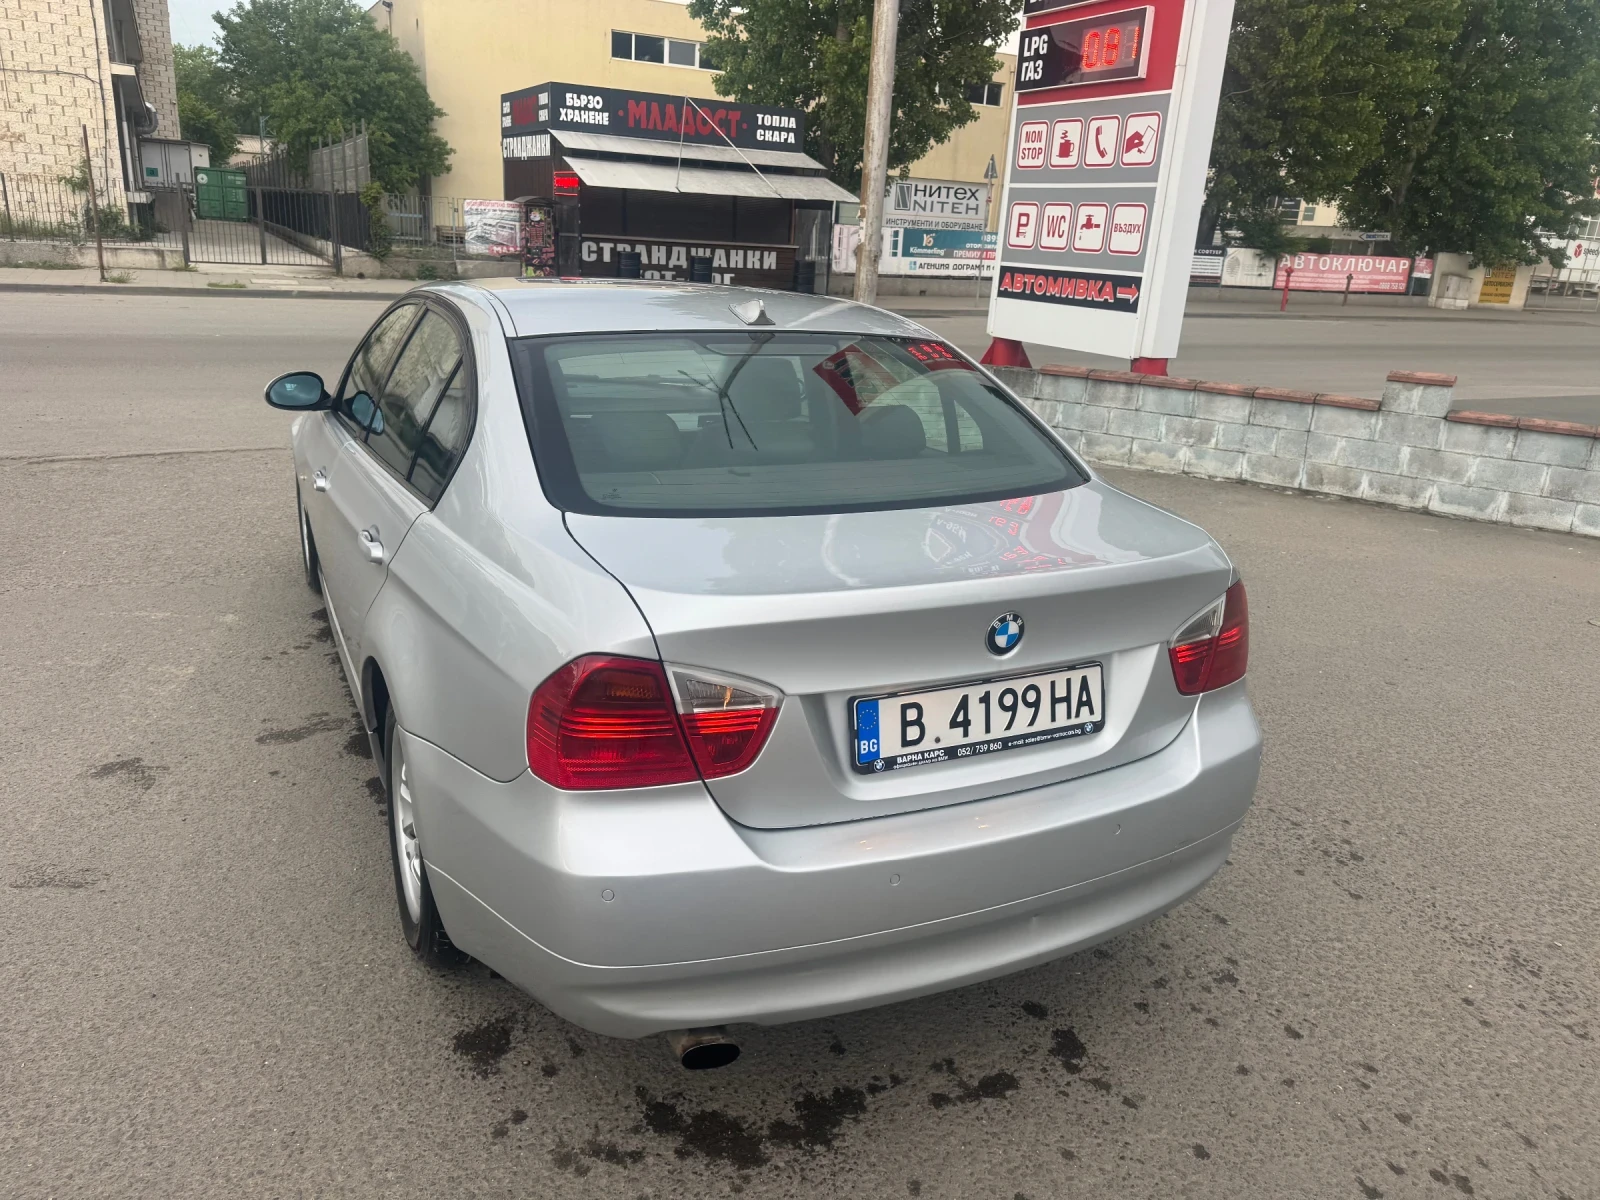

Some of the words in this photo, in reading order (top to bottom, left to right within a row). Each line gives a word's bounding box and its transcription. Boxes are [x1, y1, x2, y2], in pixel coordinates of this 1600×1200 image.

[1024, 34, 1048, 57] LPG
[1020, 60, 1043, 81] ГАЗ
[565, 92, 603, 110] БЪРЗО
[559, 107, 609, 125] ХРАНЕНЕ
[627, 99, 742, 138] МЛАДОСТ
[756, 113, 797, 129] ТОПЛА
[756, 129, 796, 144] СКАРА
[1024, 130, 1043, 143] NON
[502, 133, 551, 161] СТРАНДЖАНКИ
[1020, 147, 1043, 160] STOP
[912, 199, 979, 215] NITEH
[885, 217, 933, 228] ИНСТРУМЕНТИ
[941, 221, 984, 231] ОБОРУДВАНЕ
[1046, 215, 1067, 238] WC
[1113, 223, 1142, 235] ВЪЗДУХ
[1280, 254, 1409, 273] АВТОКЛЮЧАР
[1000, 272, 1115, 302] АВТОМИВКА
[860, 738, 878, 755] BG
[957, 747, 974, 757] 052/
[975, 745, 988, 755] 739
[989, 742, 1003, 752] 860
[896, 753, 923, 764] ВАРНА
[924, 750, 945, 759] КАРС
